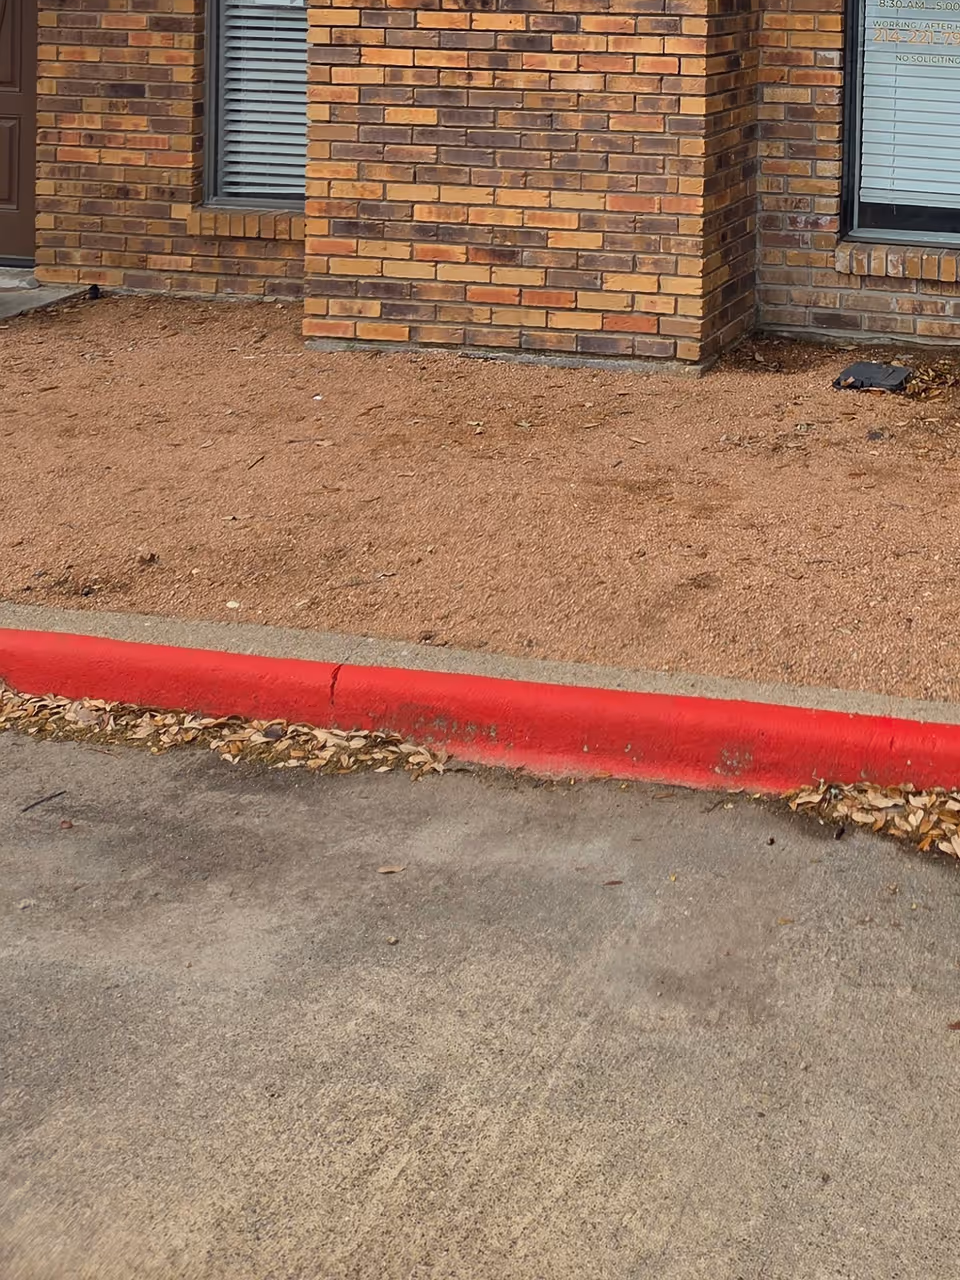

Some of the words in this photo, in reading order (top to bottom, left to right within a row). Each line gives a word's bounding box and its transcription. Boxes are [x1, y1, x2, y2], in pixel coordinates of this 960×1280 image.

[879, 0, 902, 9] 8:30
[904, 1, 925, 9] AM
[936, 2, 960, 11] 5:00
[873, 20, 918, 28] WORKING
[925, 22, 952, 30] AFTER
[896, 54, 908, 62] NO
[912, 56, 960, 64] SOLICITING
